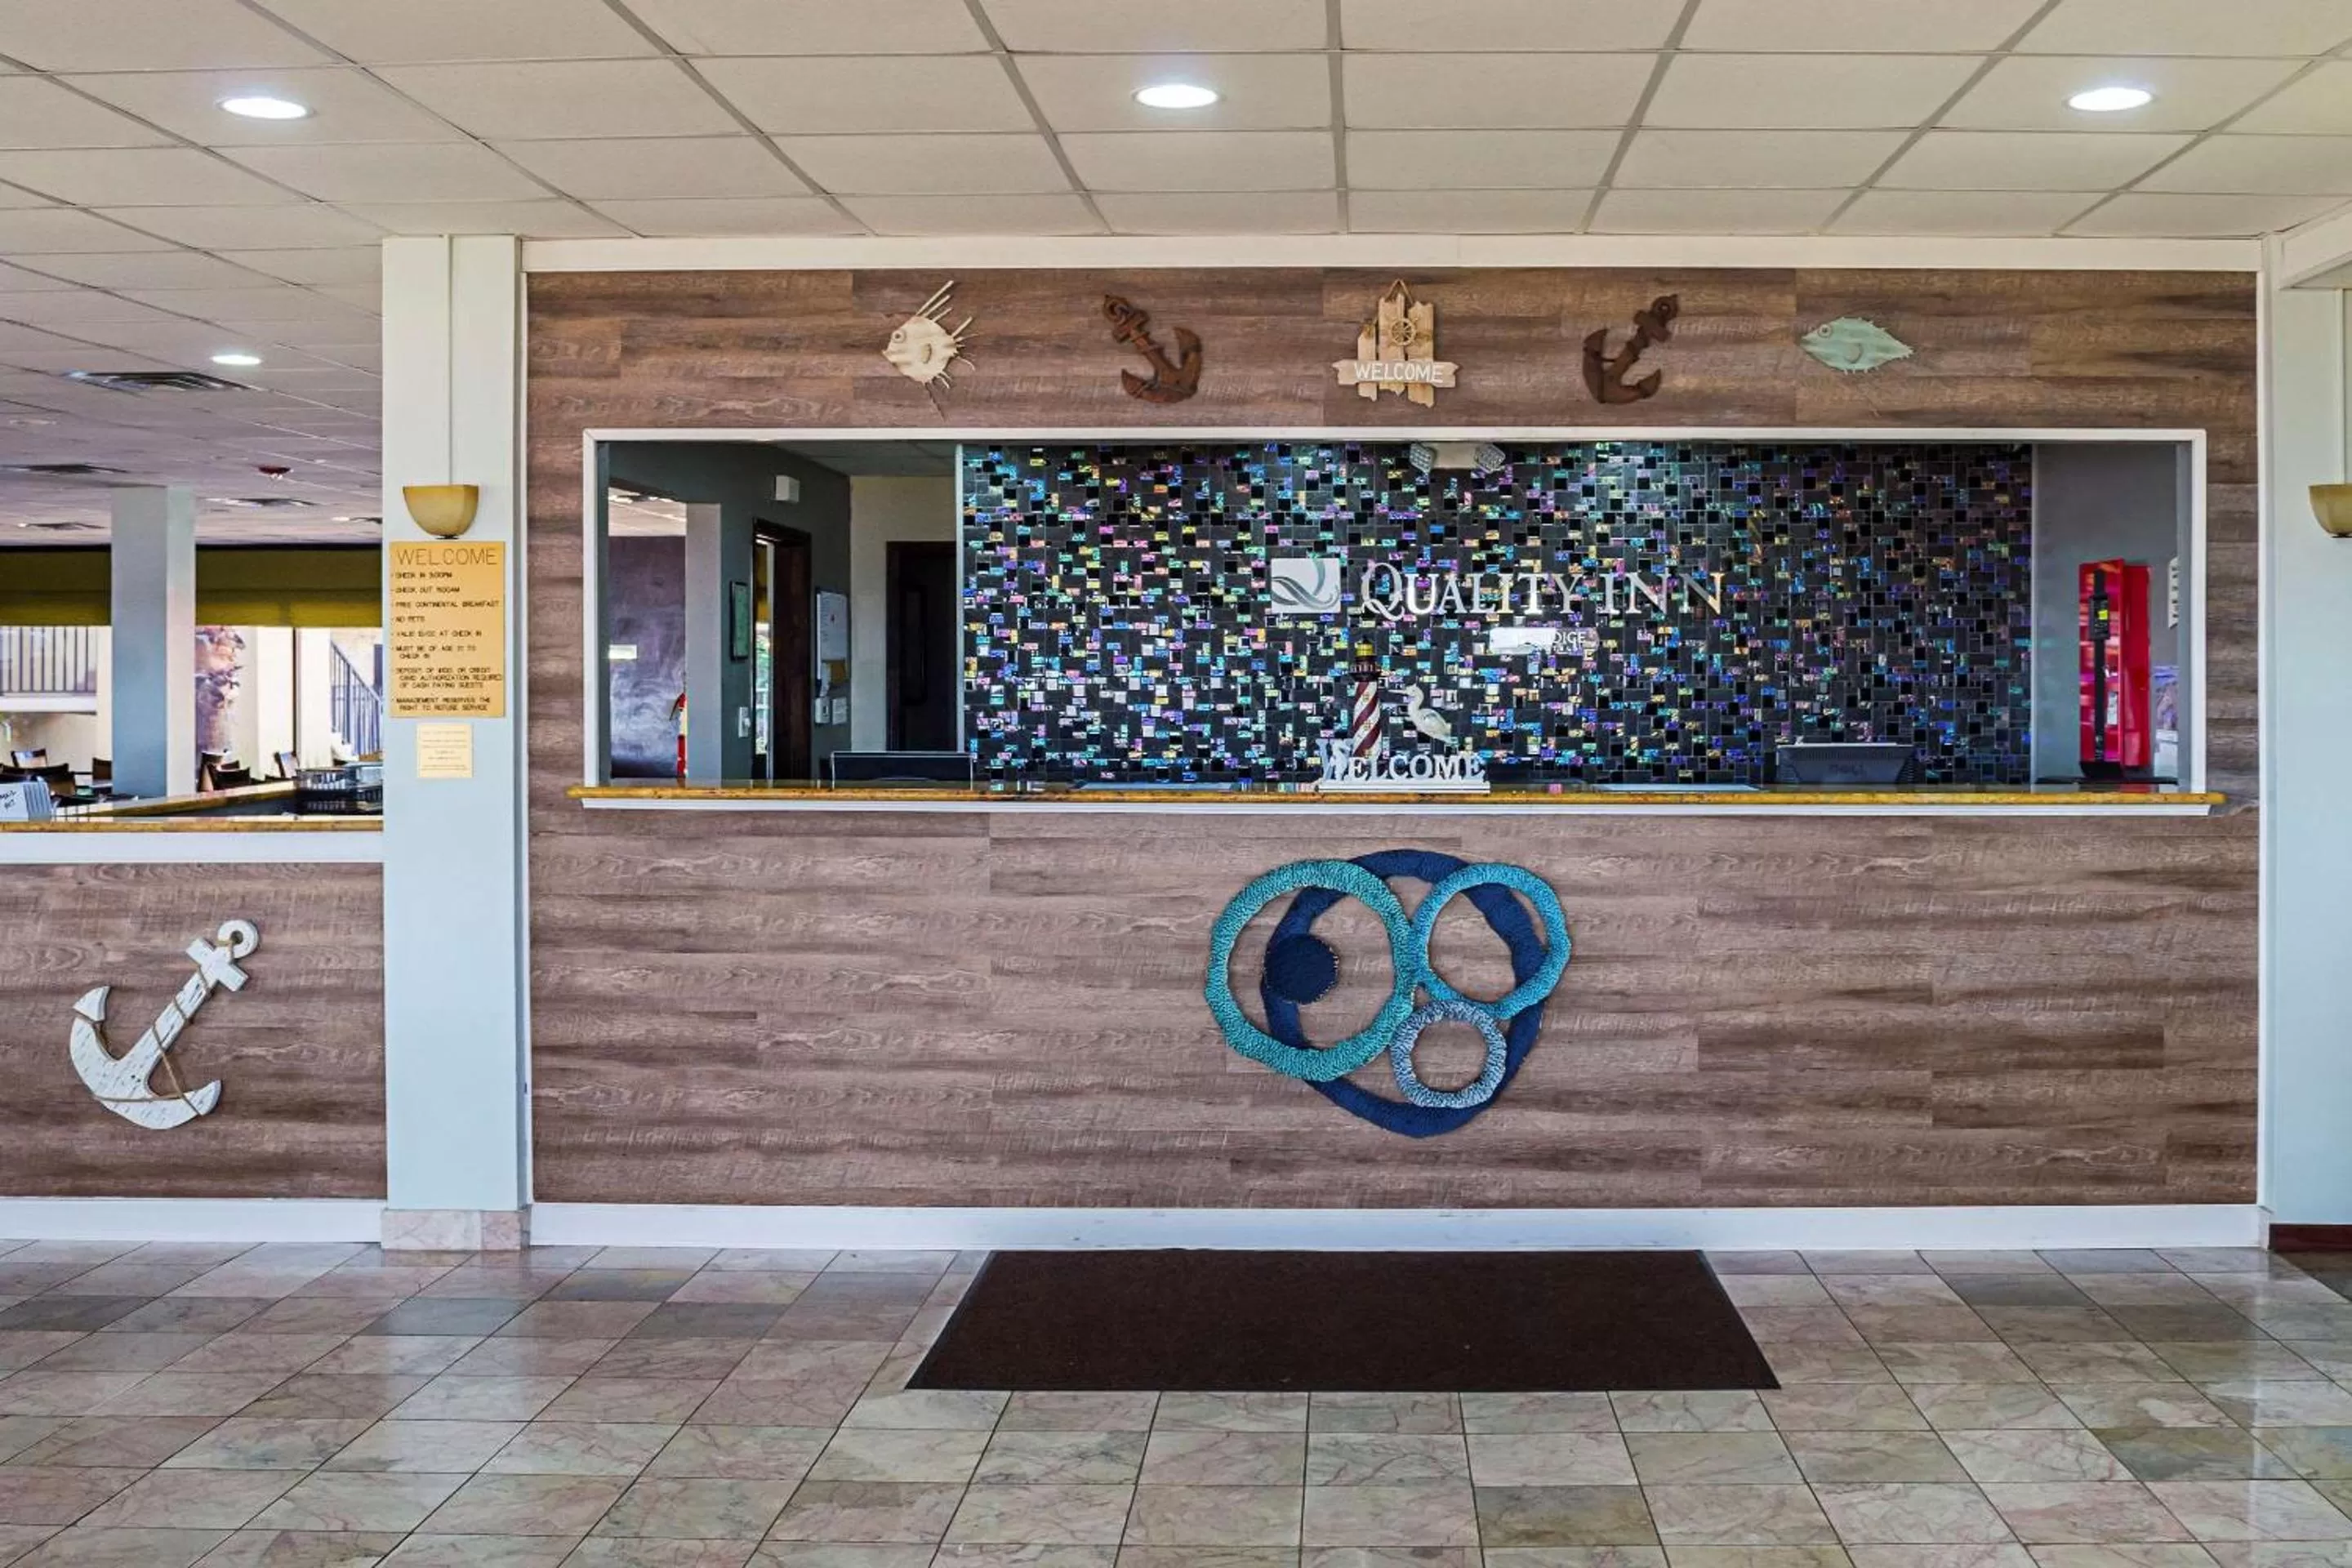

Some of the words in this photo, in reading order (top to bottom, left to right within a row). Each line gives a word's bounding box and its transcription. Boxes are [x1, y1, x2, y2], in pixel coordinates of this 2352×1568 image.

[1354, 363, 1444, 383] WELCOME
[396, 548, 497, 565] WELCOME
[1361, 562, 1583, 622] QUALITY
[1599, 570, 1725, 615] INN
